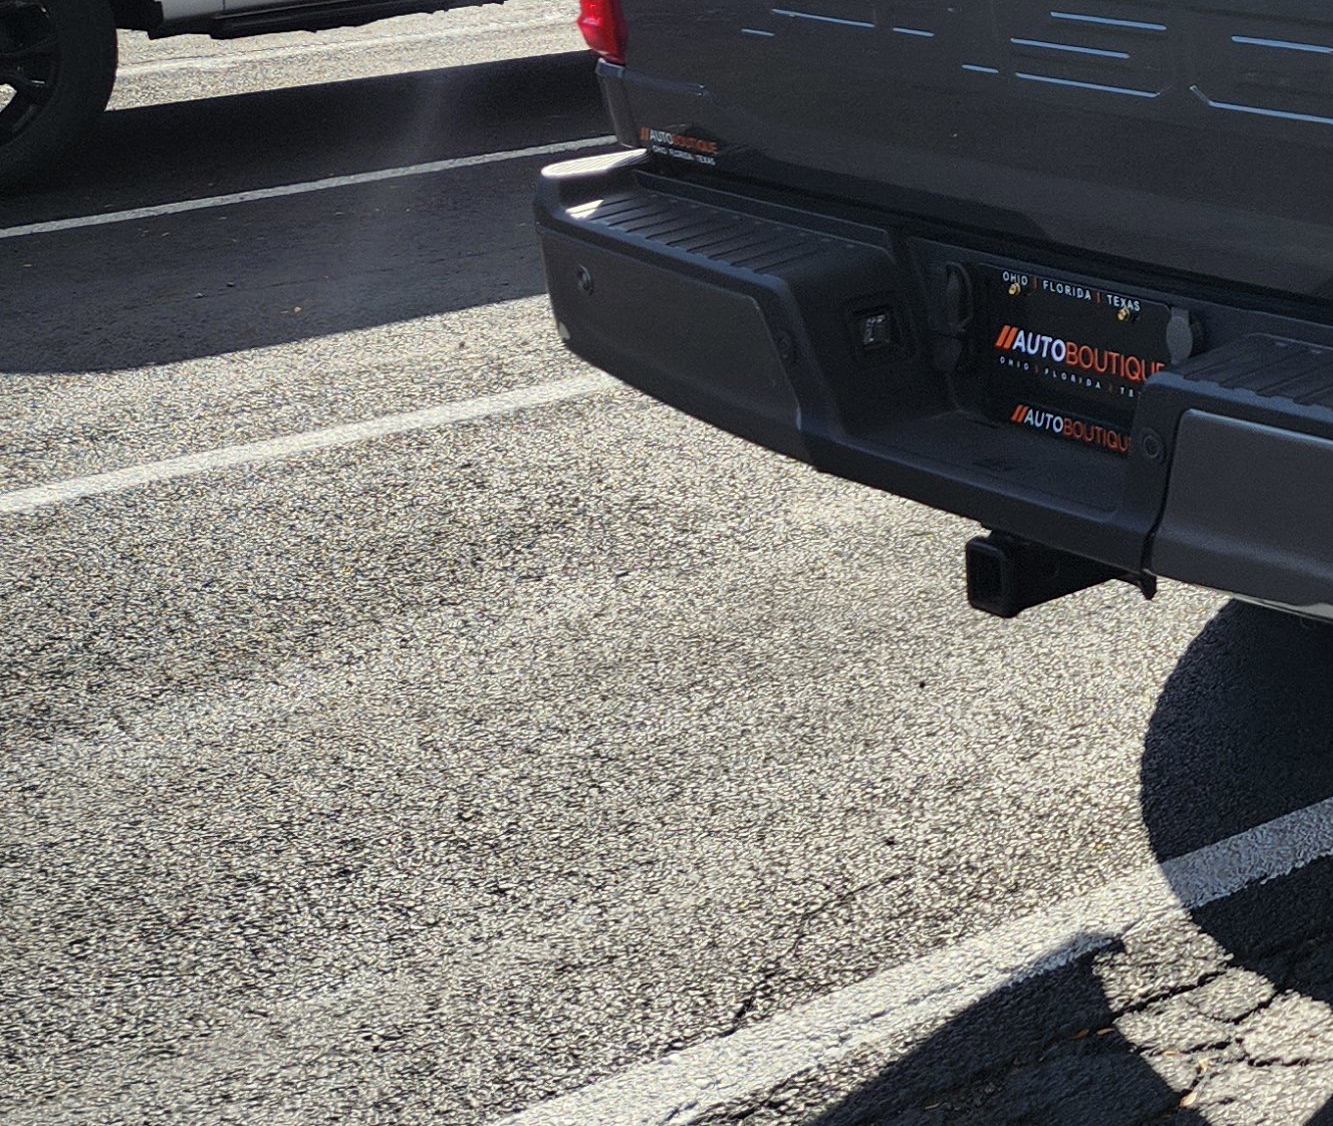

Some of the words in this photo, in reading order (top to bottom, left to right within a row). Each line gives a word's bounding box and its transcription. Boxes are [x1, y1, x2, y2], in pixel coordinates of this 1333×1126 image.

[1002, 270, 1029, 286] OHIO
[1042, 279, 1092, 301] FLORIDA
[1106, 294, 1141, 312] TEXAS
[1044, 367, 1102, 390] FLORIDA
